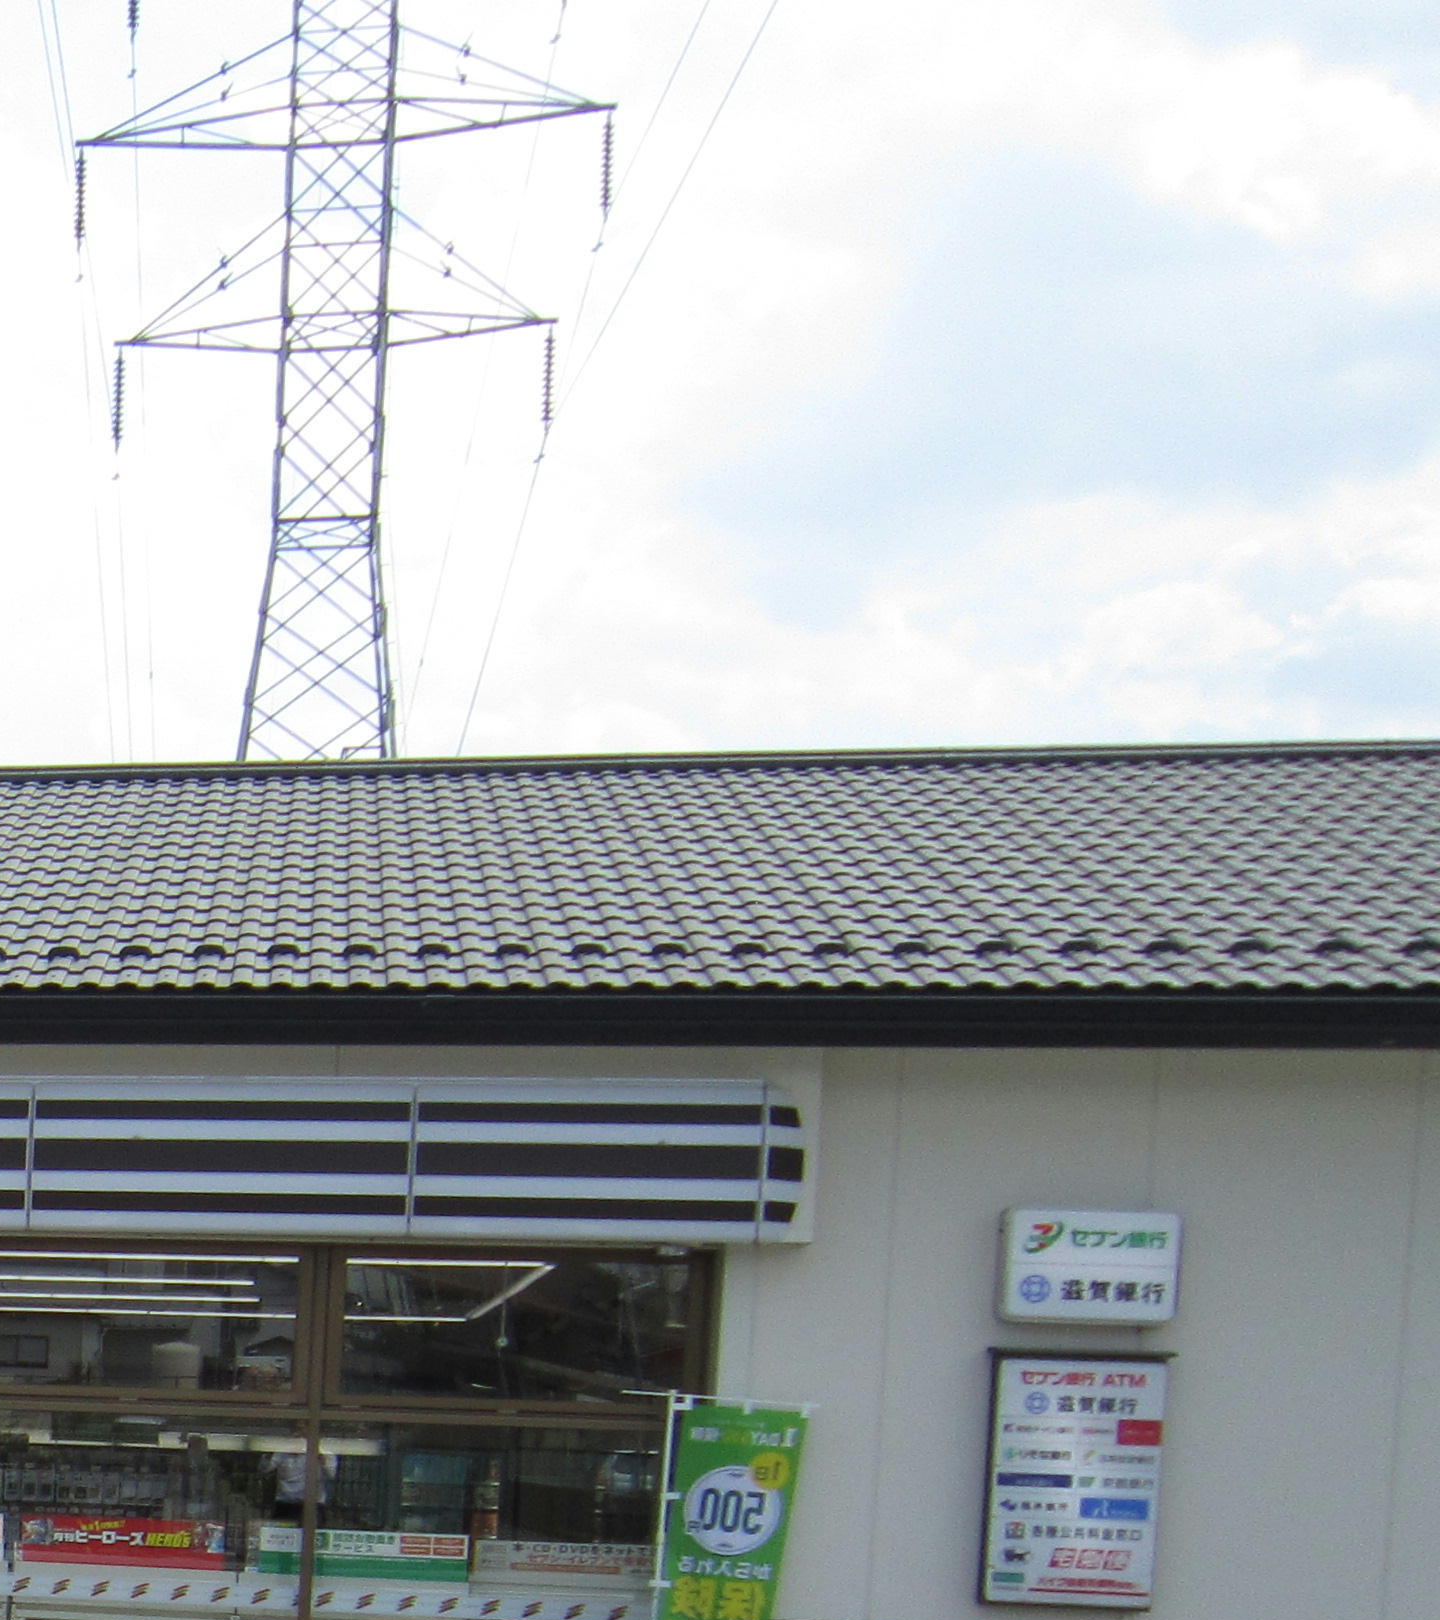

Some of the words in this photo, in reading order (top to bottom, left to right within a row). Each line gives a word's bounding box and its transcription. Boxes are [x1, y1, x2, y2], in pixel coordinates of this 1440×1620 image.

[1071, 1229, 1169, 1249] セブン銀行
[1060, 1279, 1166, 1304] 滋賀銀行
[1102, 1373, 1148, 1388] ATM
